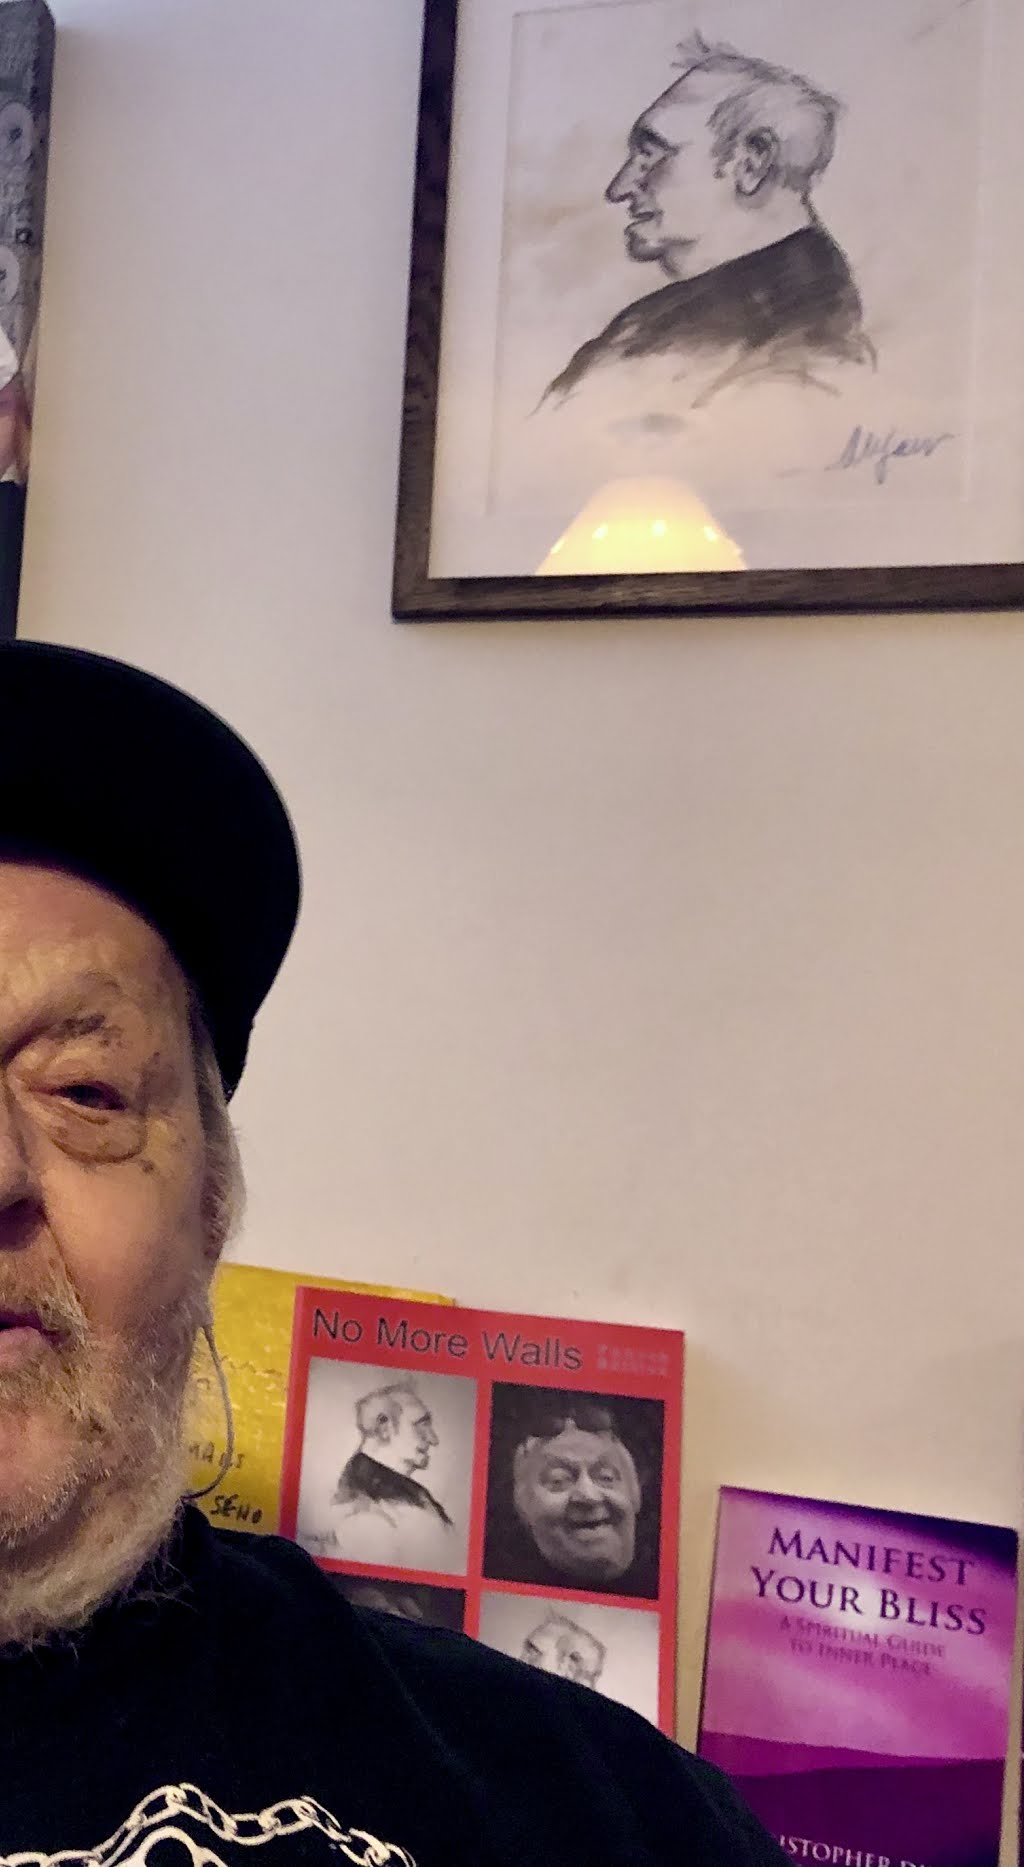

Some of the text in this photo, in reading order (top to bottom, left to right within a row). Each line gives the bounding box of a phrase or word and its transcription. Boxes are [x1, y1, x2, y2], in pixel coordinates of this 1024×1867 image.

[312, 1308, 363, 1343] No
[376, 1317, 469, 1358] More
[482, 1330, 584, 1372] Walls
[768, 1527, 975, 1585] MANIFEST
[750, 1566, 987, 1635] YOUR BLISS
[779, 1834, 892, 1867] ISTOPHER
